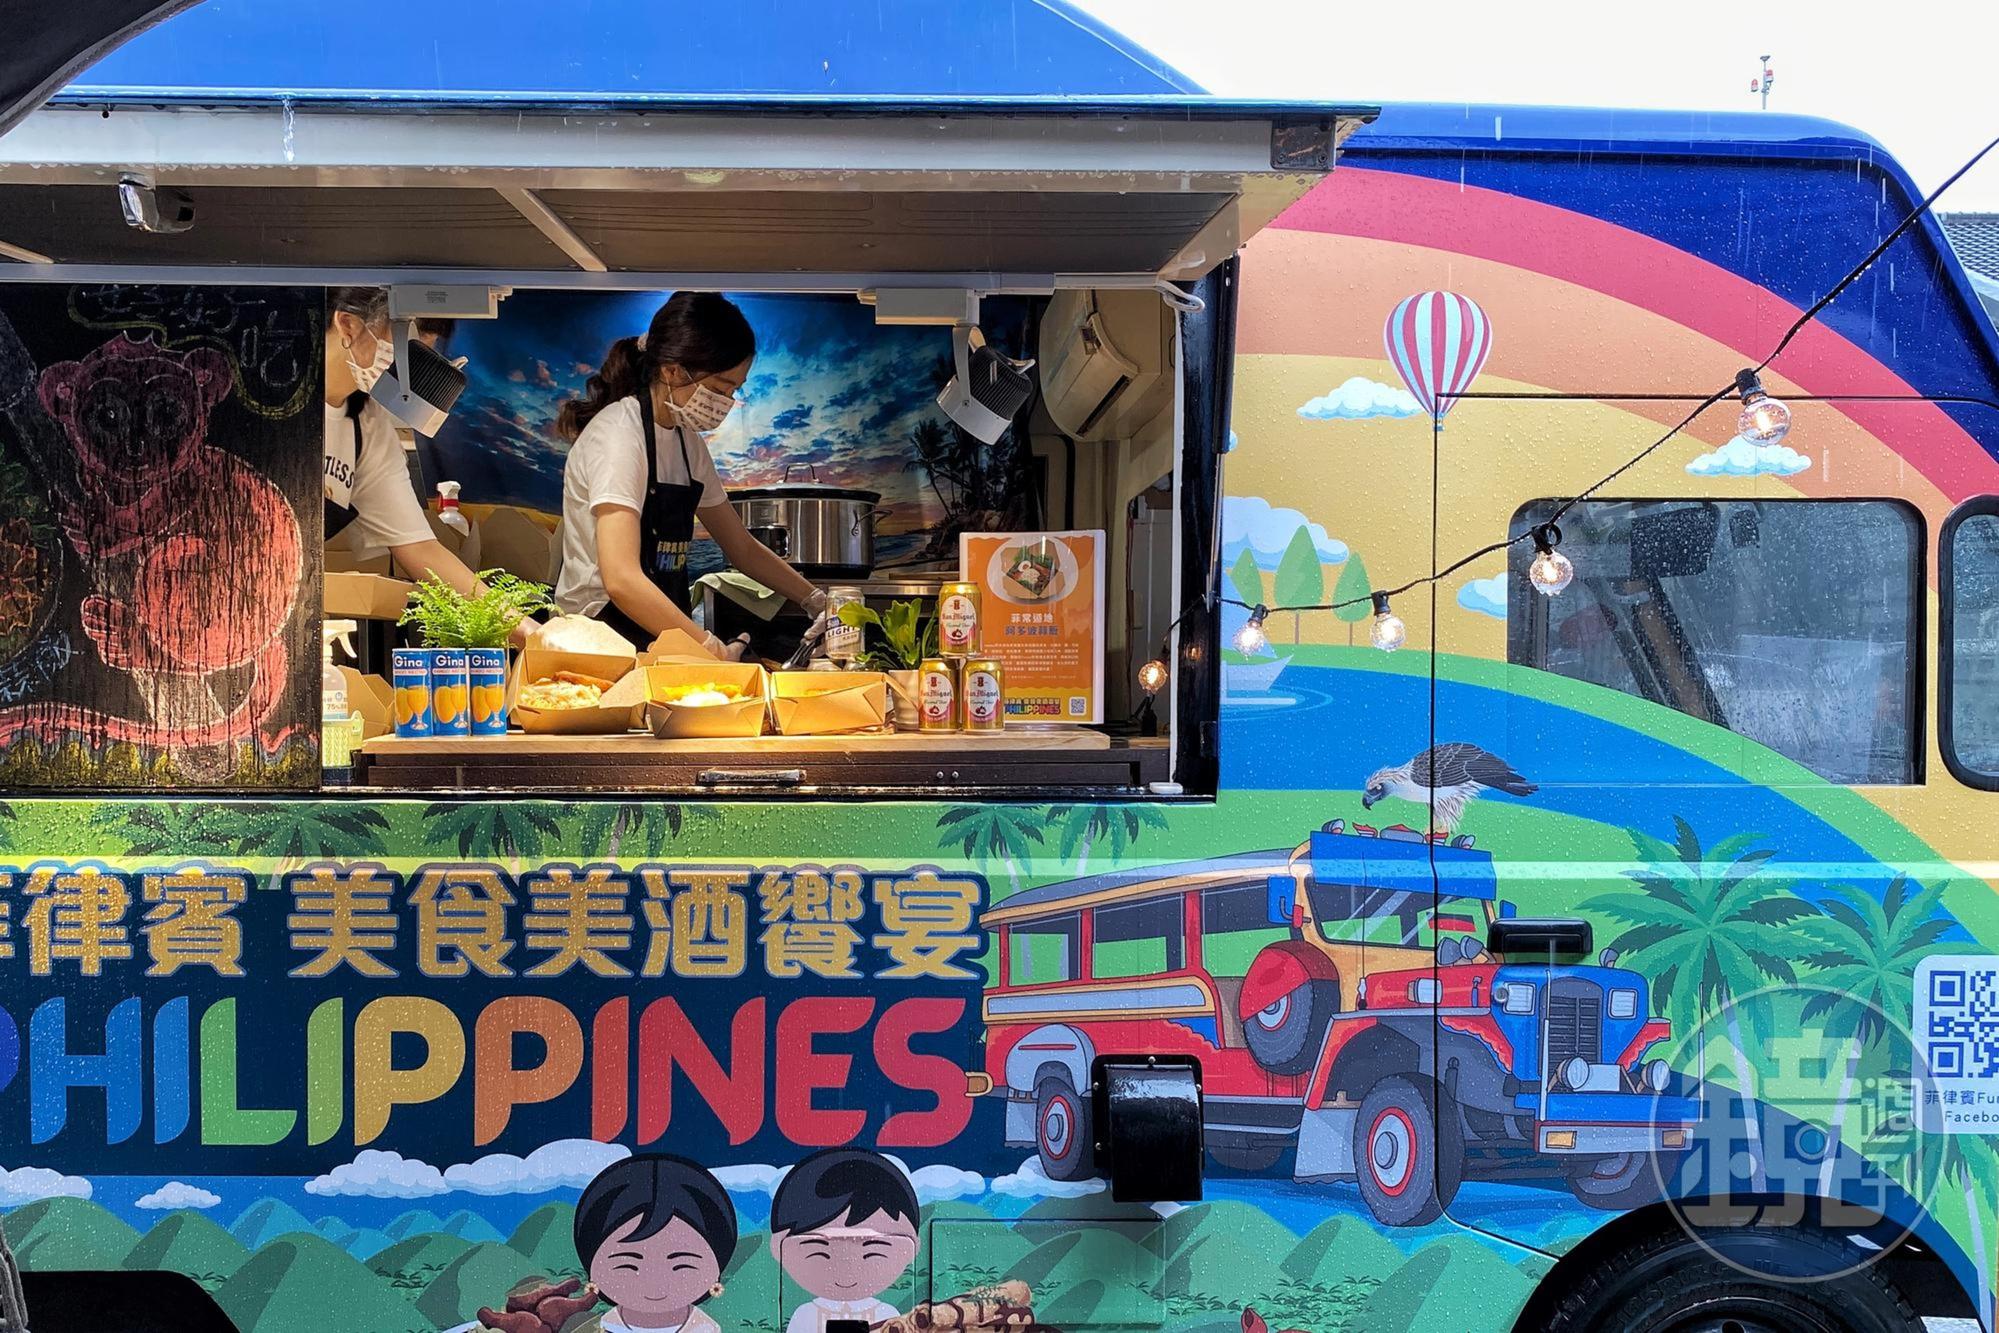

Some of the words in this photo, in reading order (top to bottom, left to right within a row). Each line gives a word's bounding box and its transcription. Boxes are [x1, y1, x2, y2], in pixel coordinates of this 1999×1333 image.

[394, 655, 423, 667] Gina
[435, 654, 464, 666] Gina
[471, 655, 500, 666] Gina
[0, 867, 248, 977] 律賓
[287, 867, 981, 979] 美食美酒饗宴
[0, 995, 973, 1147] HILIPPINES
[1924, 1089, 1999, 1105] 菲律賓Fu
